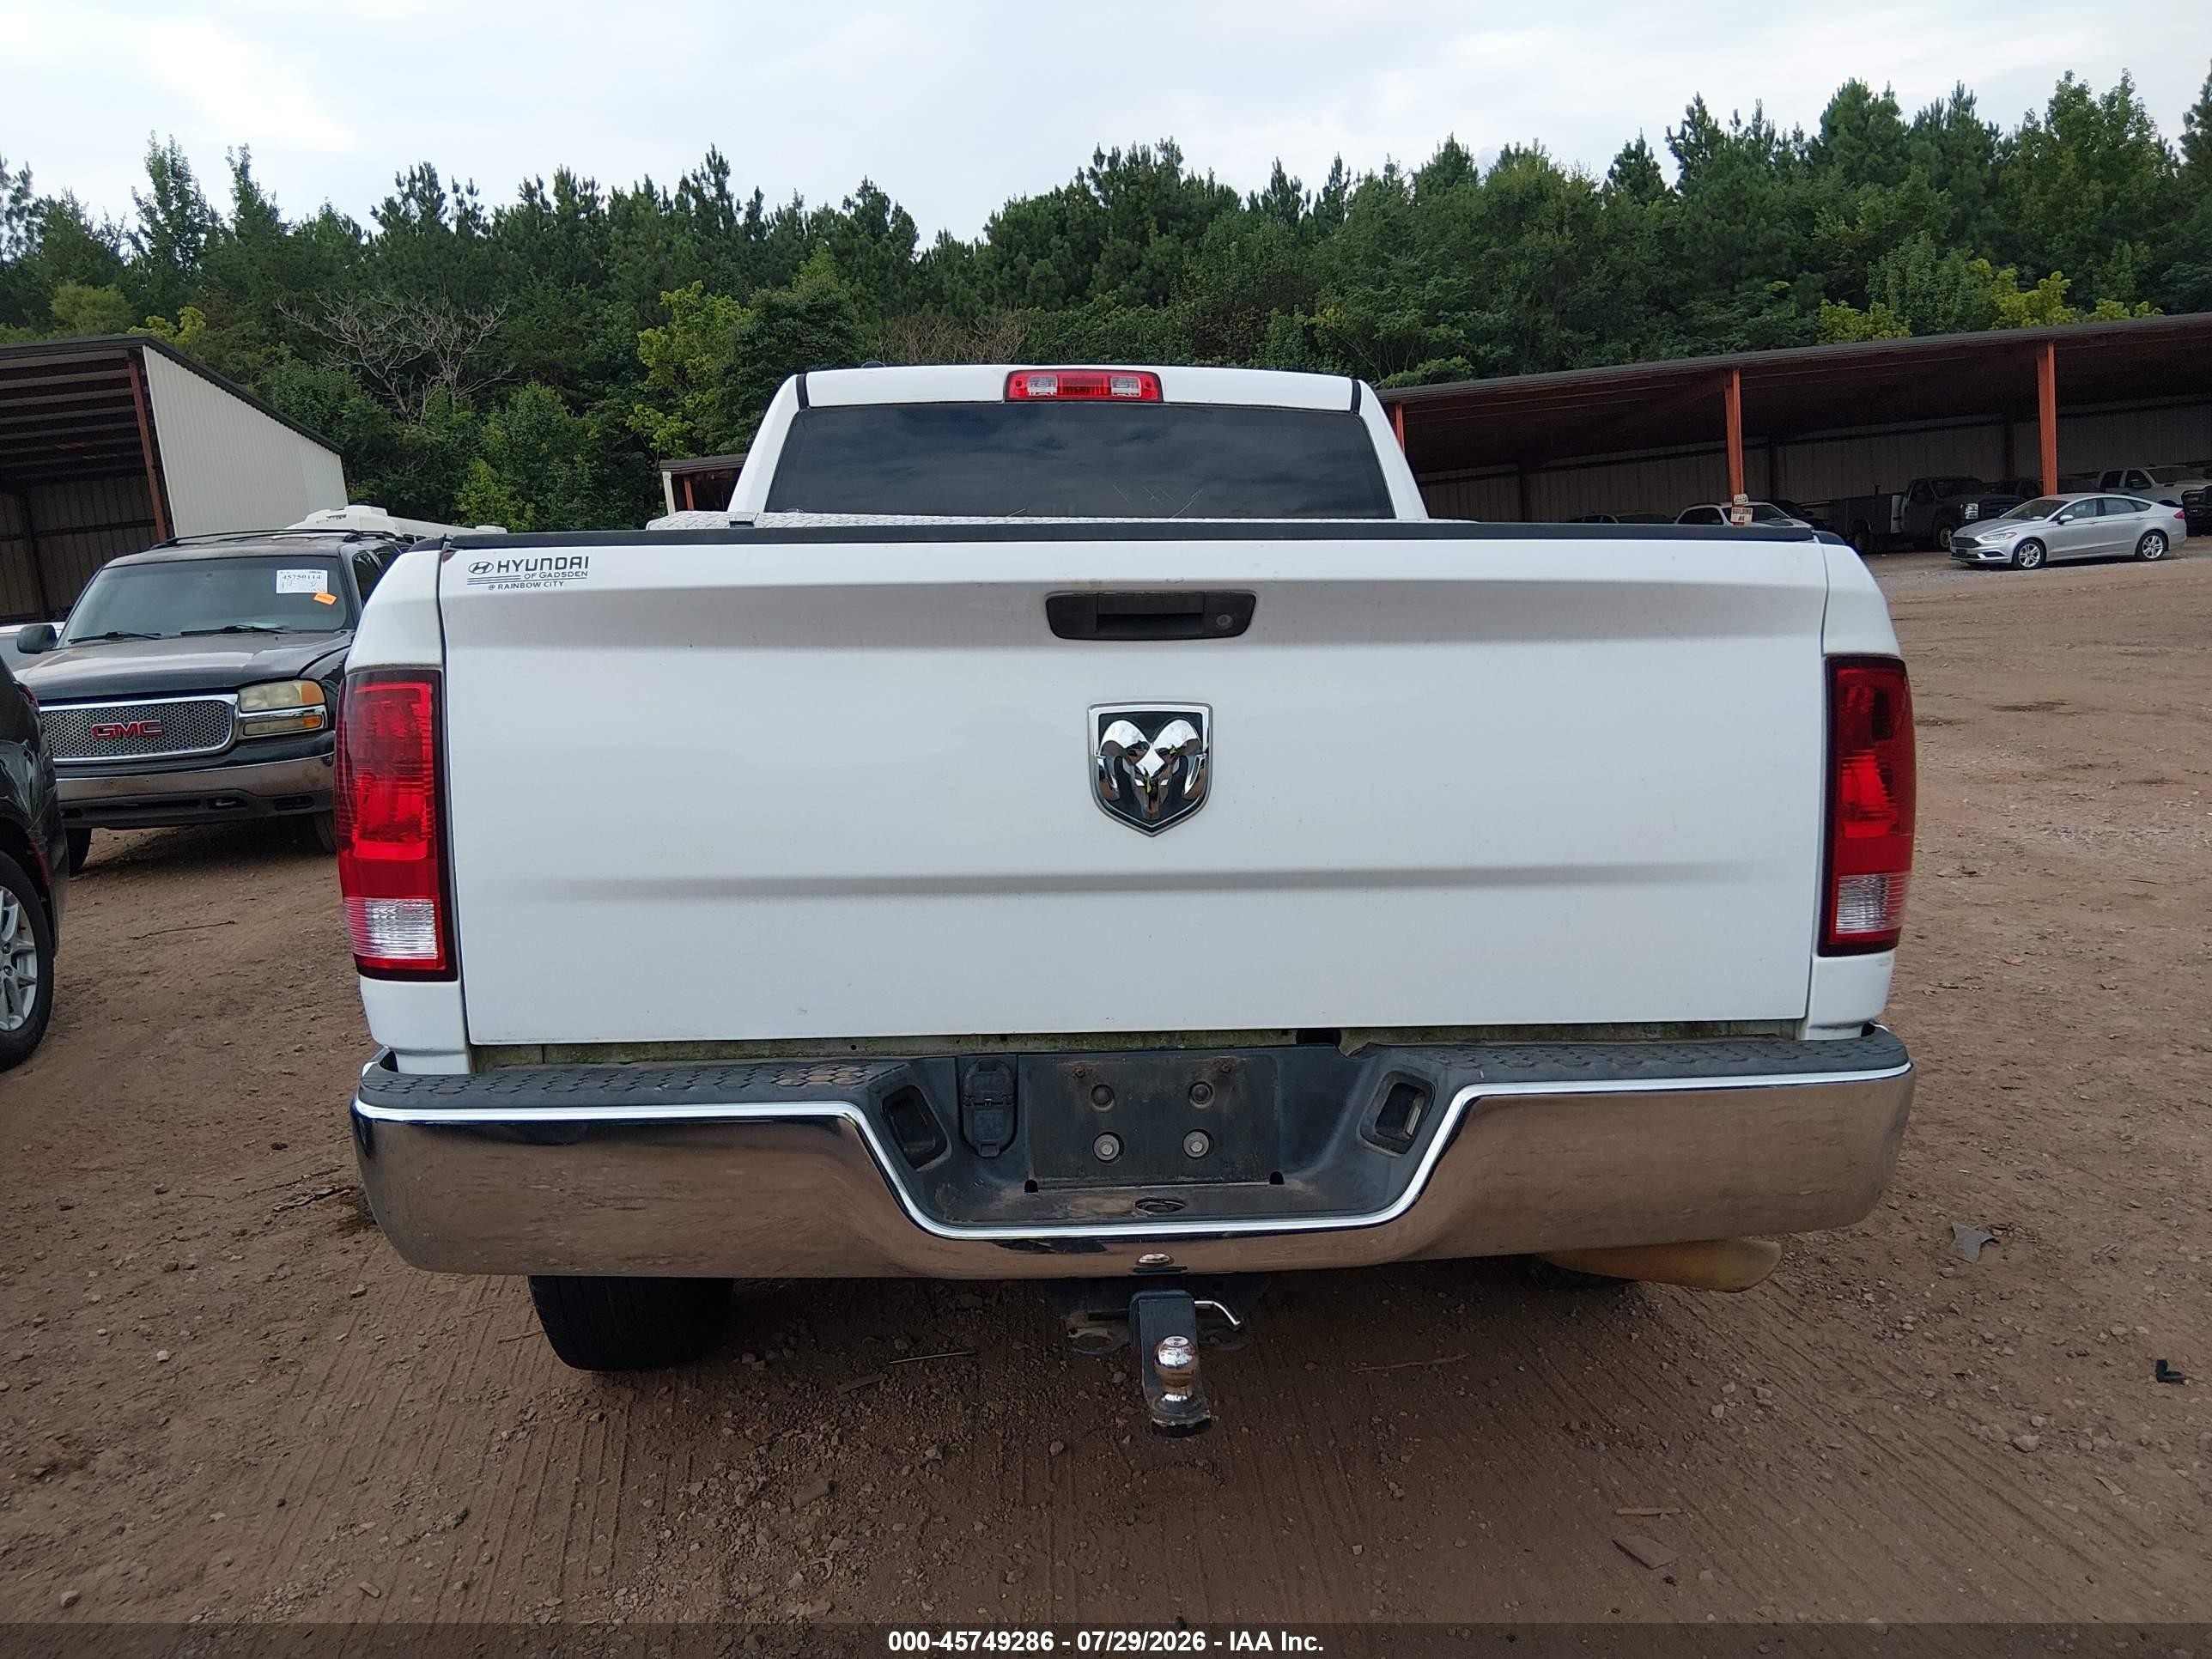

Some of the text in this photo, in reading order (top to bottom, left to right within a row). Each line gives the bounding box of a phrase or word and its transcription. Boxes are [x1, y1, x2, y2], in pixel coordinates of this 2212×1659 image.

[497, 556, 589, 573] HYUNDAI
[539, 570, 588, 579] GADSDEN
[92, 720, 162, 739] GMC
